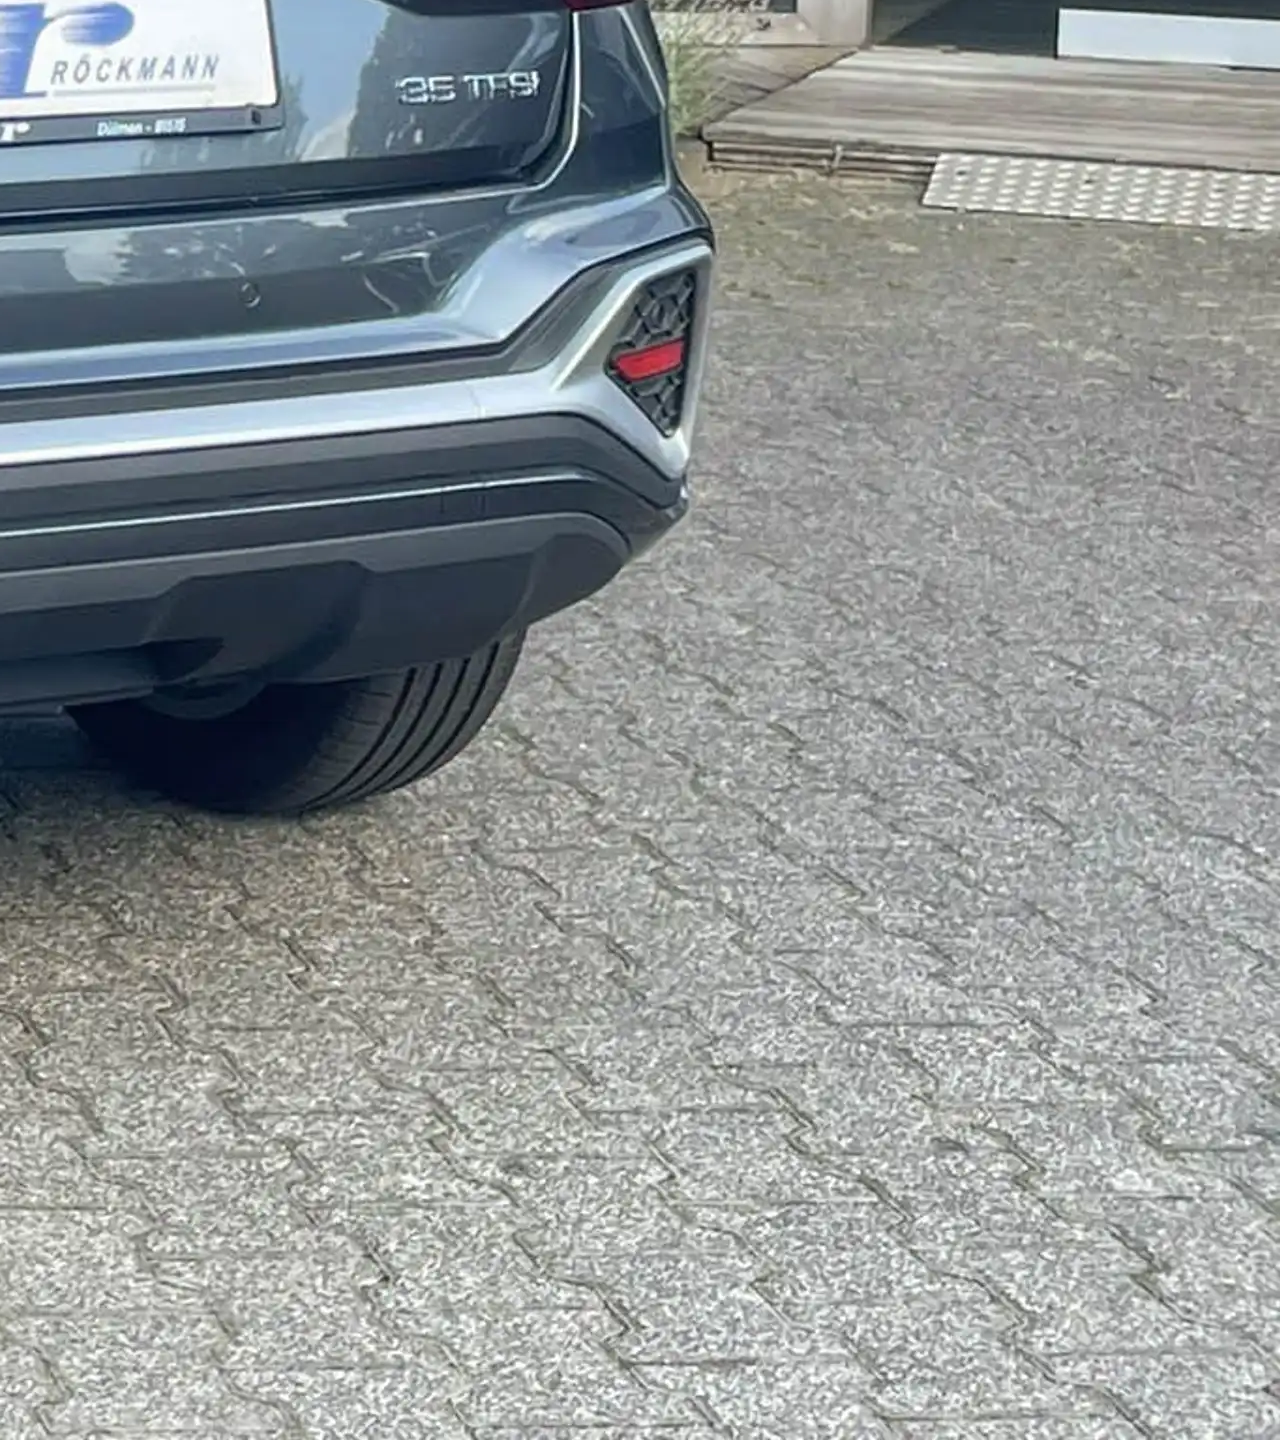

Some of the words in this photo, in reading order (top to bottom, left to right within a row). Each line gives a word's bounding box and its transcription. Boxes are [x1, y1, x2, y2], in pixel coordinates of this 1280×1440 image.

[50, 53, 220, 87] RÖCKMANN
[395, 74, 457, 105] 35
[462, 69, 540, 101] TFSI
